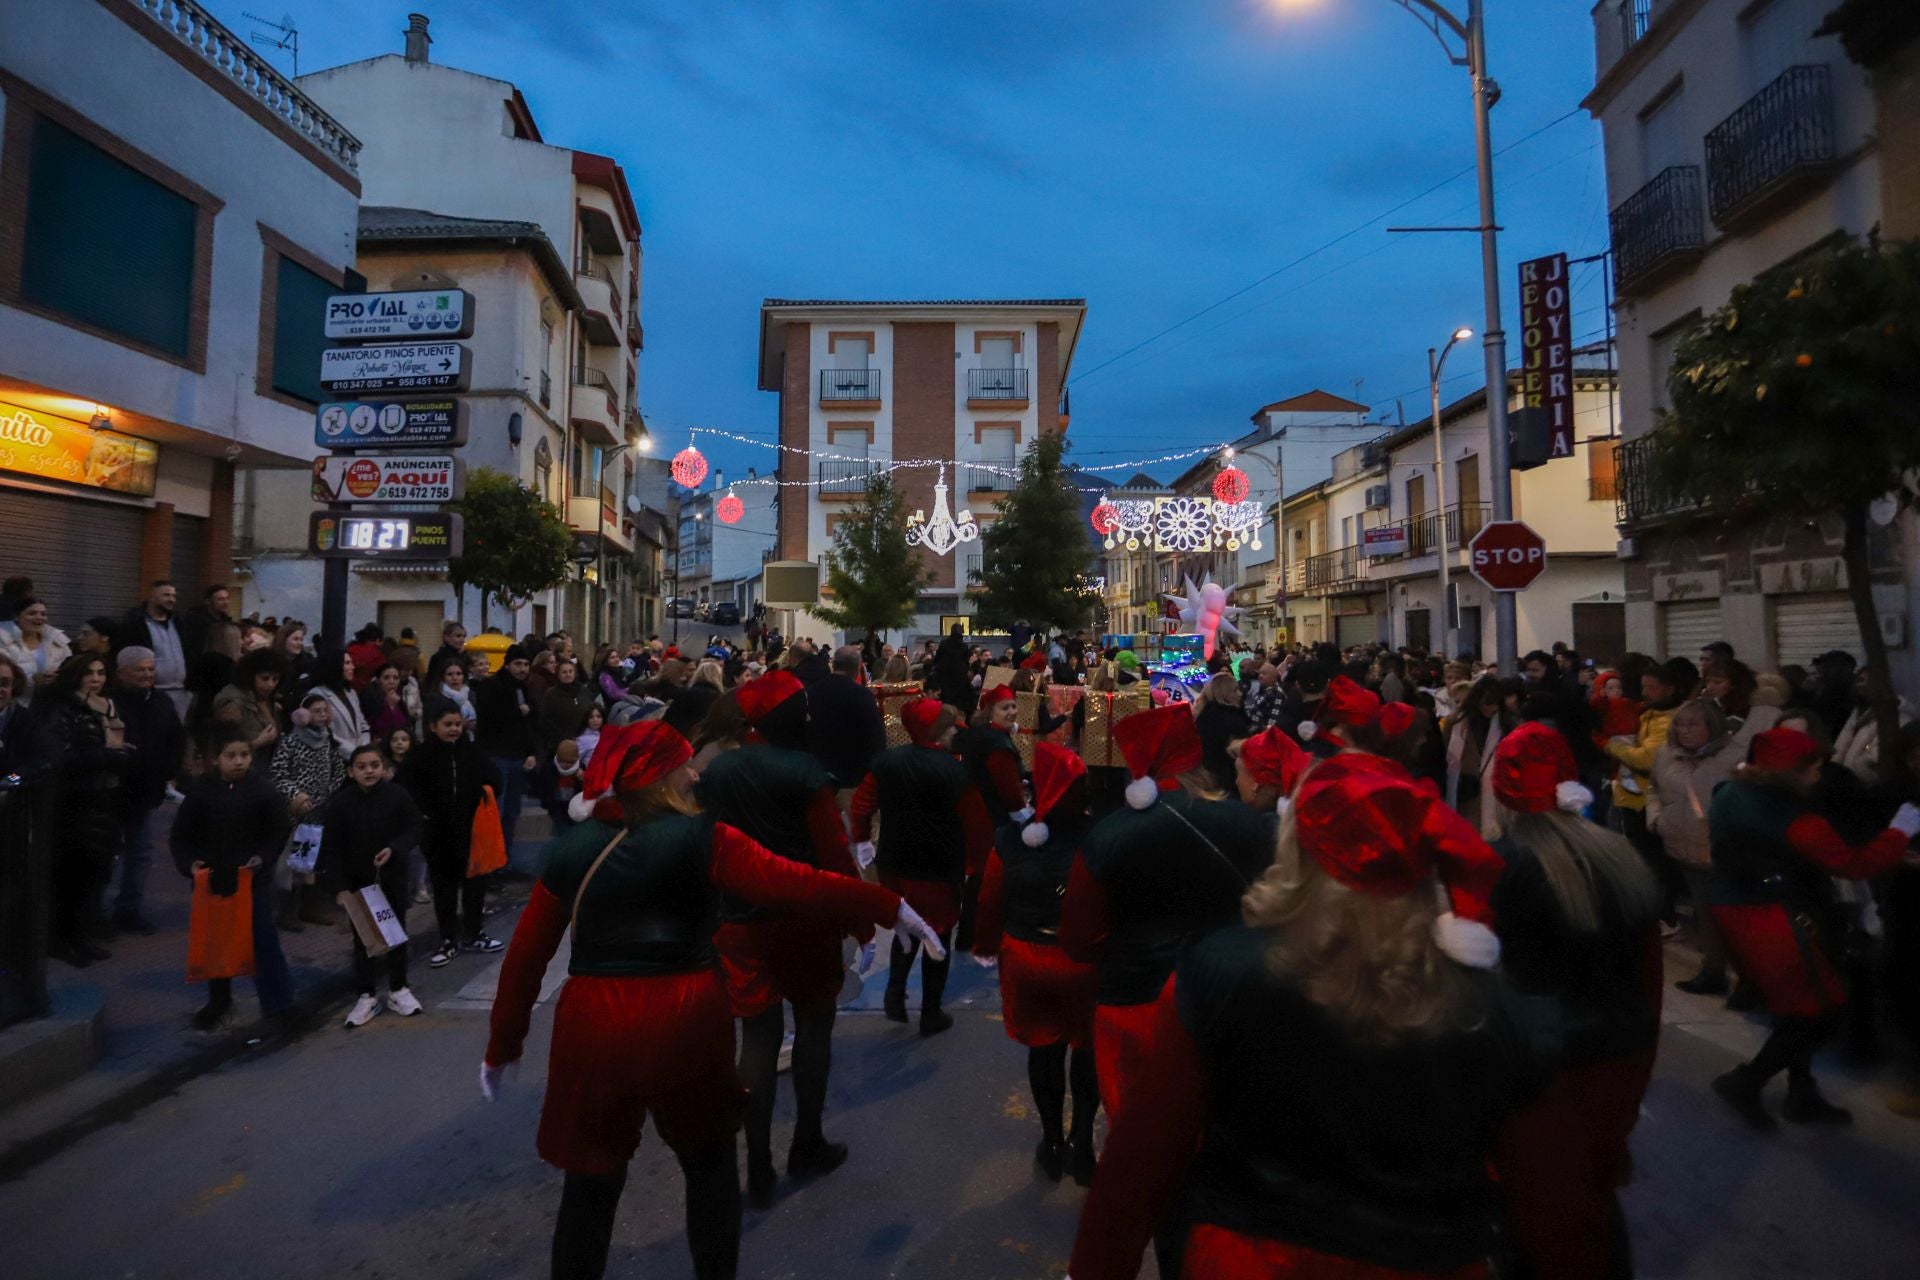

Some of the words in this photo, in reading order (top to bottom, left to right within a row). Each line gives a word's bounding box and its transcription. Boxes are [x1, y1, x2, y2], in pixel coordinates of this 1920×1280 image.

[330, 297, 407, 318] PROVIAL
[326, 349, 381, 361] TANATORIO
[384, 347, 415, 359] PINOS
[417, 346, 455, 357] PUENTE
[1545, 257, 1570, 456] JOYERIA
[332, 380, 348, 390] 610
[350, 380, 366, 389] 347
[367, 379, 382, 388] 025
[398, 378, 414, 387] 958
[416, 377, 431, 386] 451
[434, 376, 449, 385] 147
[351, 463, 371, 475] ¿me
[384, 459, 451, 470] ANÚNCIATE
[357, 471, 379, 481] ves?
[384, 470, 449, 486] AQUÍ
[388, 487, 407, 498] 619
[409, 487, 427, 498] 472
[431, 487, 449, 498] 758
[415, 526, 444, 535] PINOS
[411, 536, 447, 545] PUENTE
[1474, 548, 1541, 565] STOP
